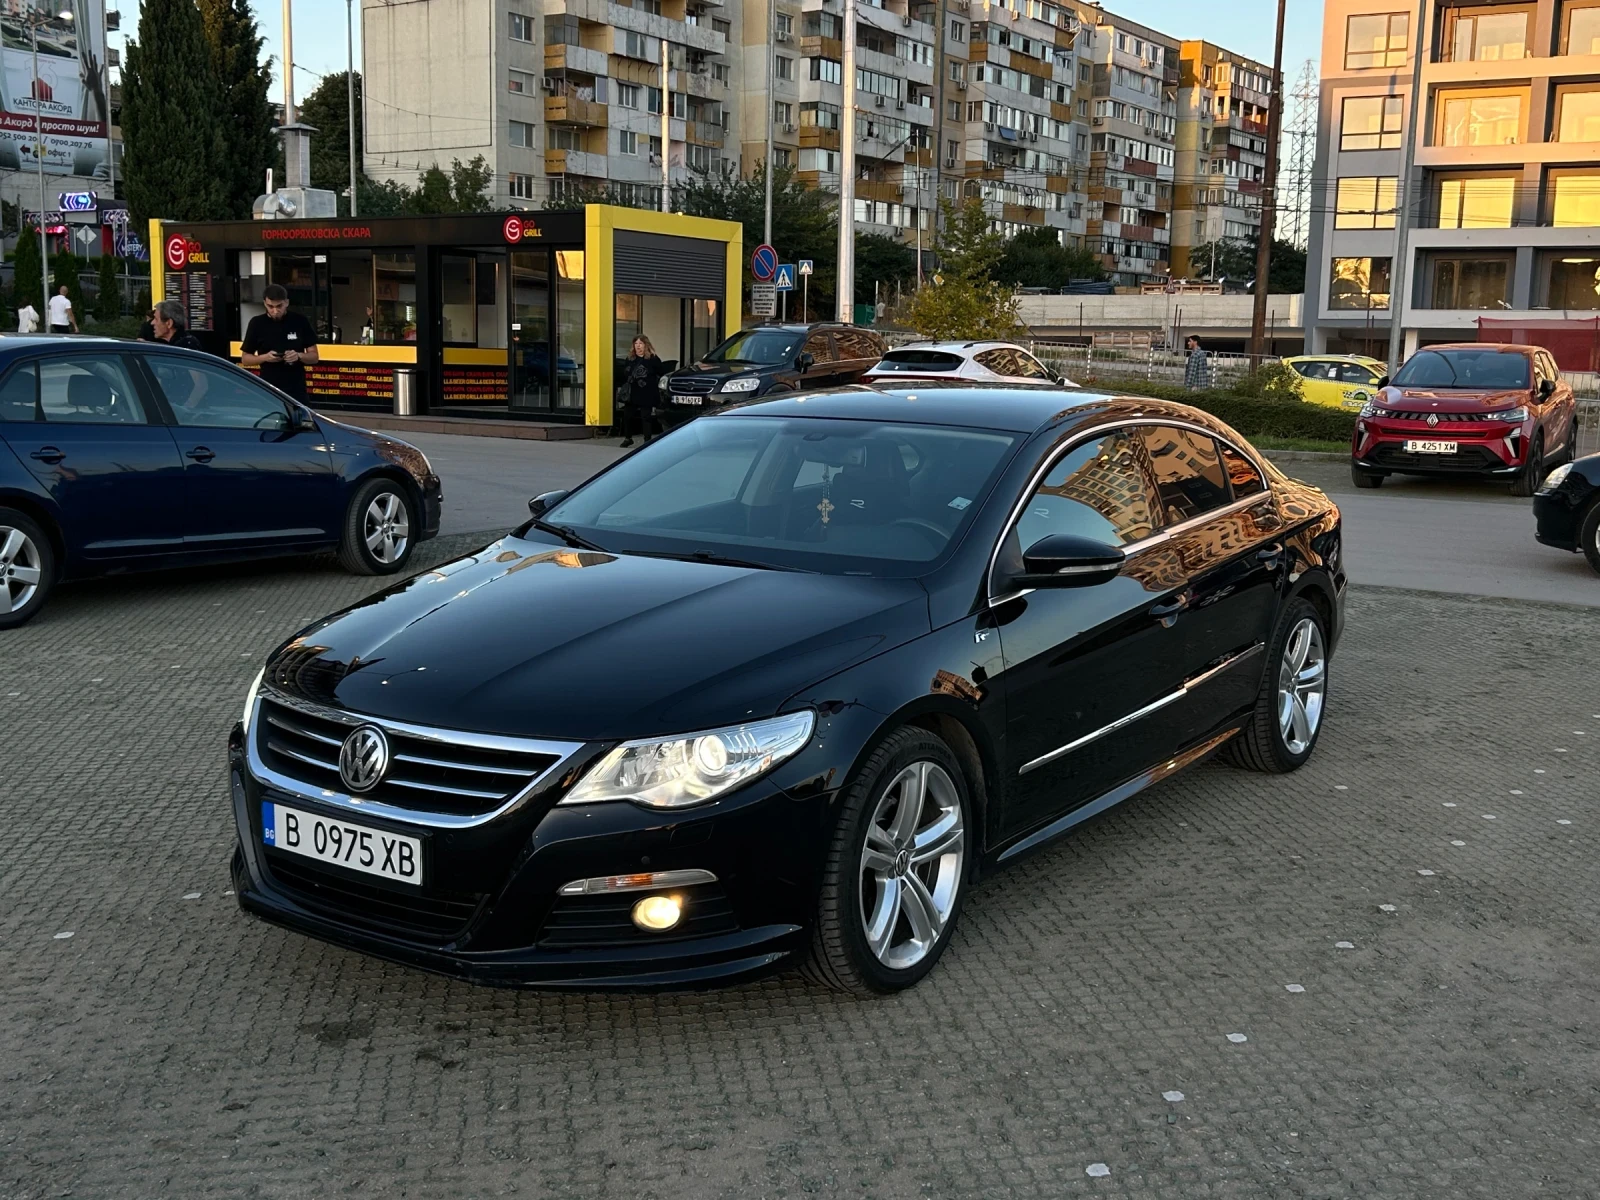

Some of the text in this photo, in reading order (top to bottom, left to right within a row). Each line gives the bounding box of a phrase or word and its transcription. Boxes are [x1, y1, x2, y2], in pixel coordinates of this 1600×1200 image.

[13, 98, 47, 109] КАНТОРА
[48, 103, 72, 114] АКОРД
[4, 116, 33, 129] Акорд
[41, 121, 75, 132] просто
[76, 124, 99, 135] шум!
[13, 133, 27, 141] 500
[47, 148, 67, 158] офис
[523, 220, 535, 229] GO
[262, 227, 371, 239] ГОРНООРЯХОВСКА СКАРА
[523, 229, 542, 237] GRILL
[121, 243, 143, 252] MSTERY
[188, 241, 201, 252] GO
[188, 253, 210, 263] GRILL
[1411, 442, 1456, 451] B 4251 XM
[265, 827, 275, 840] BG
[286, 812, 416, 878] B 0975 XB
